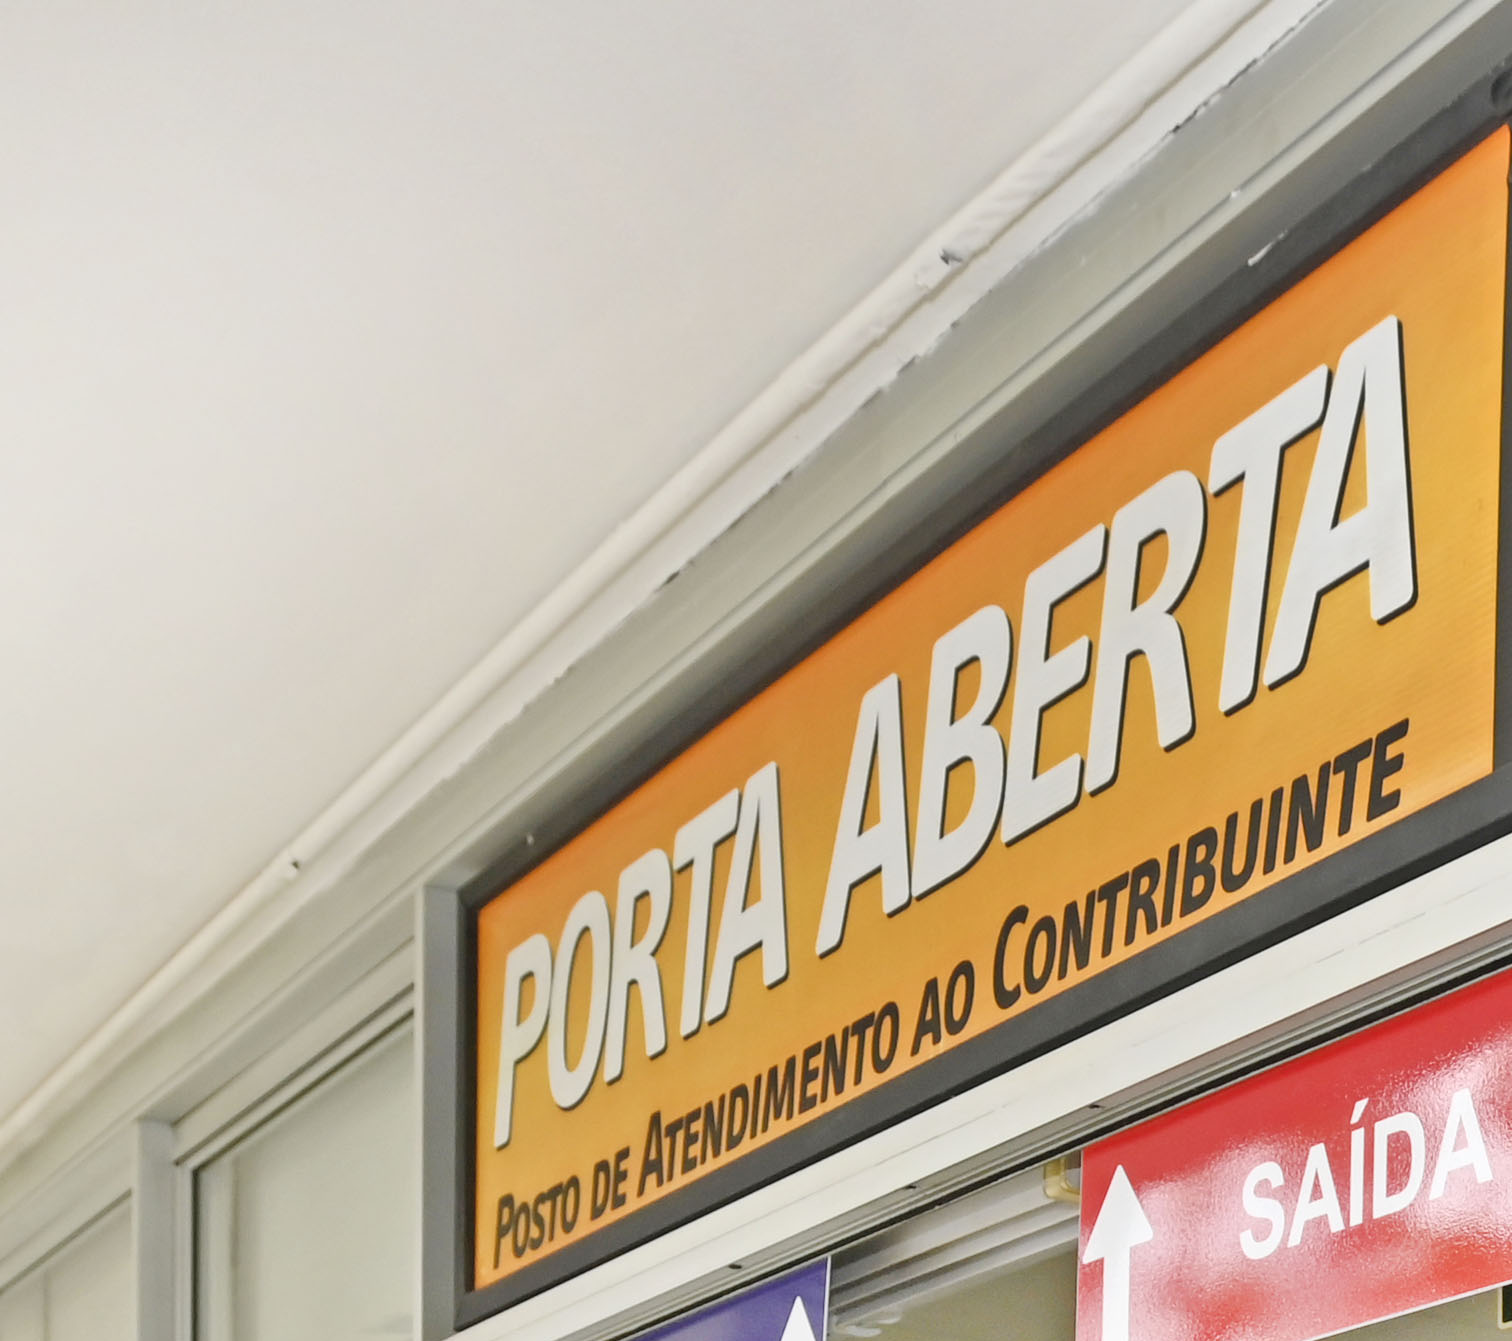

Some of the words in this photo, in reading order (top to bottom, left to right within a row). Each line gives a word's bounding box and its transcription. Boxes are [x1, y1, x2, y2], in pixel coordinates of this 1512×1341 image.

[494, 760, 790, 1149] PORTA
[815, 314, 1418, 958] ABERTA
[1238, 1088, 1493, 1262] SAÍDA
